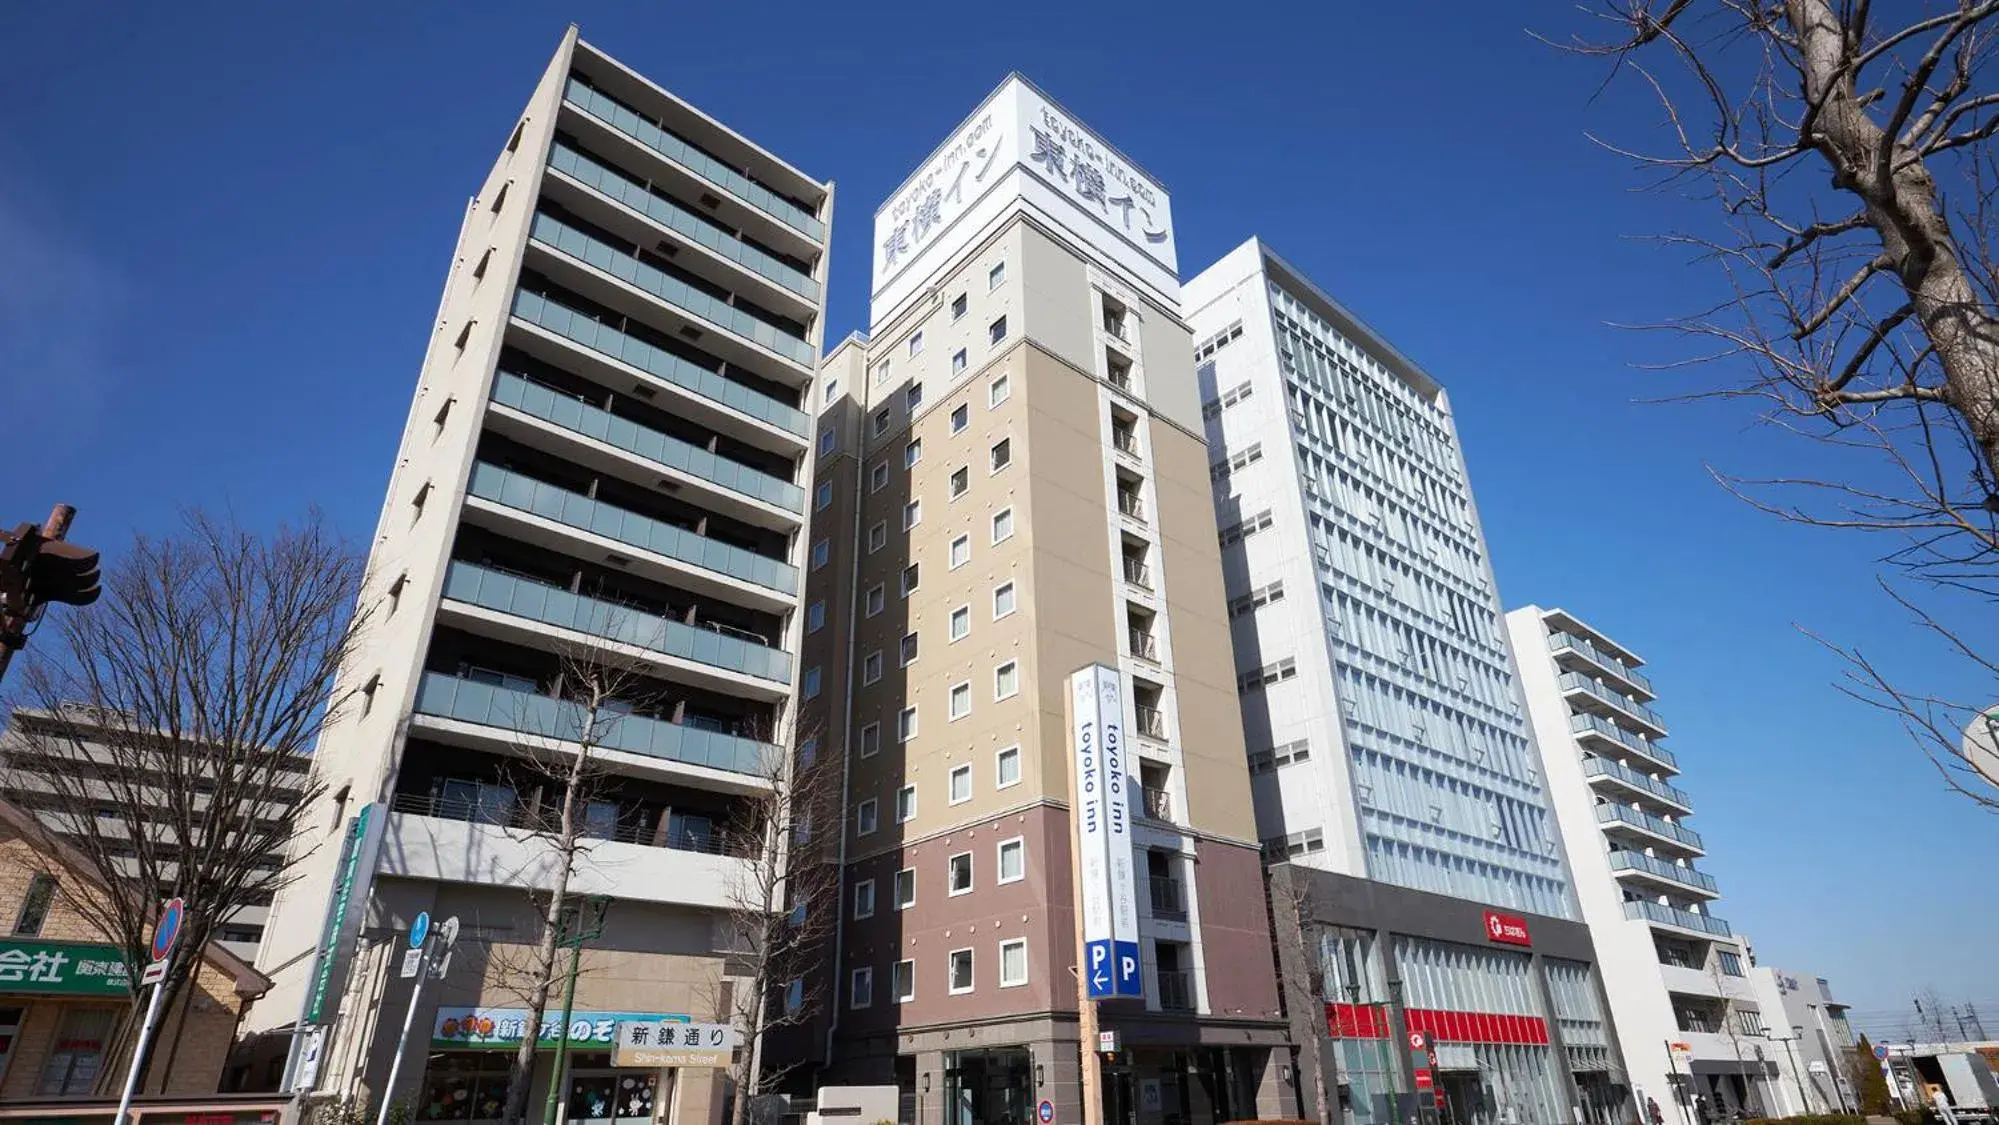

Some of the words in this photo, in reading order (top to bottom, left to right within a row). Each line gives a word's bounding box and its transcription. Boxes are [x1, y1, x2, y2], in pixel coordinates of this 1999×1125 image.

[890, 113, 993, 222] toyoko-inn.com
[1040, 106, 1156, 208] toyoko-inn.com
[1029, 124, 1168, 244] 東横イン
[1081, 721, 1097, 793] toyoko
[1106, 723, 1122, 794] toyoko
[1086, 799, 1098, 833] inn
[1112, 801, 1125, 834] inn
[1092, 945, 1106, 970] P
[1121, 956, 1136, 981] P
[631, 1026, 724, 1046] 新鎌通り
[689, 1054, 718, 1065] Street
